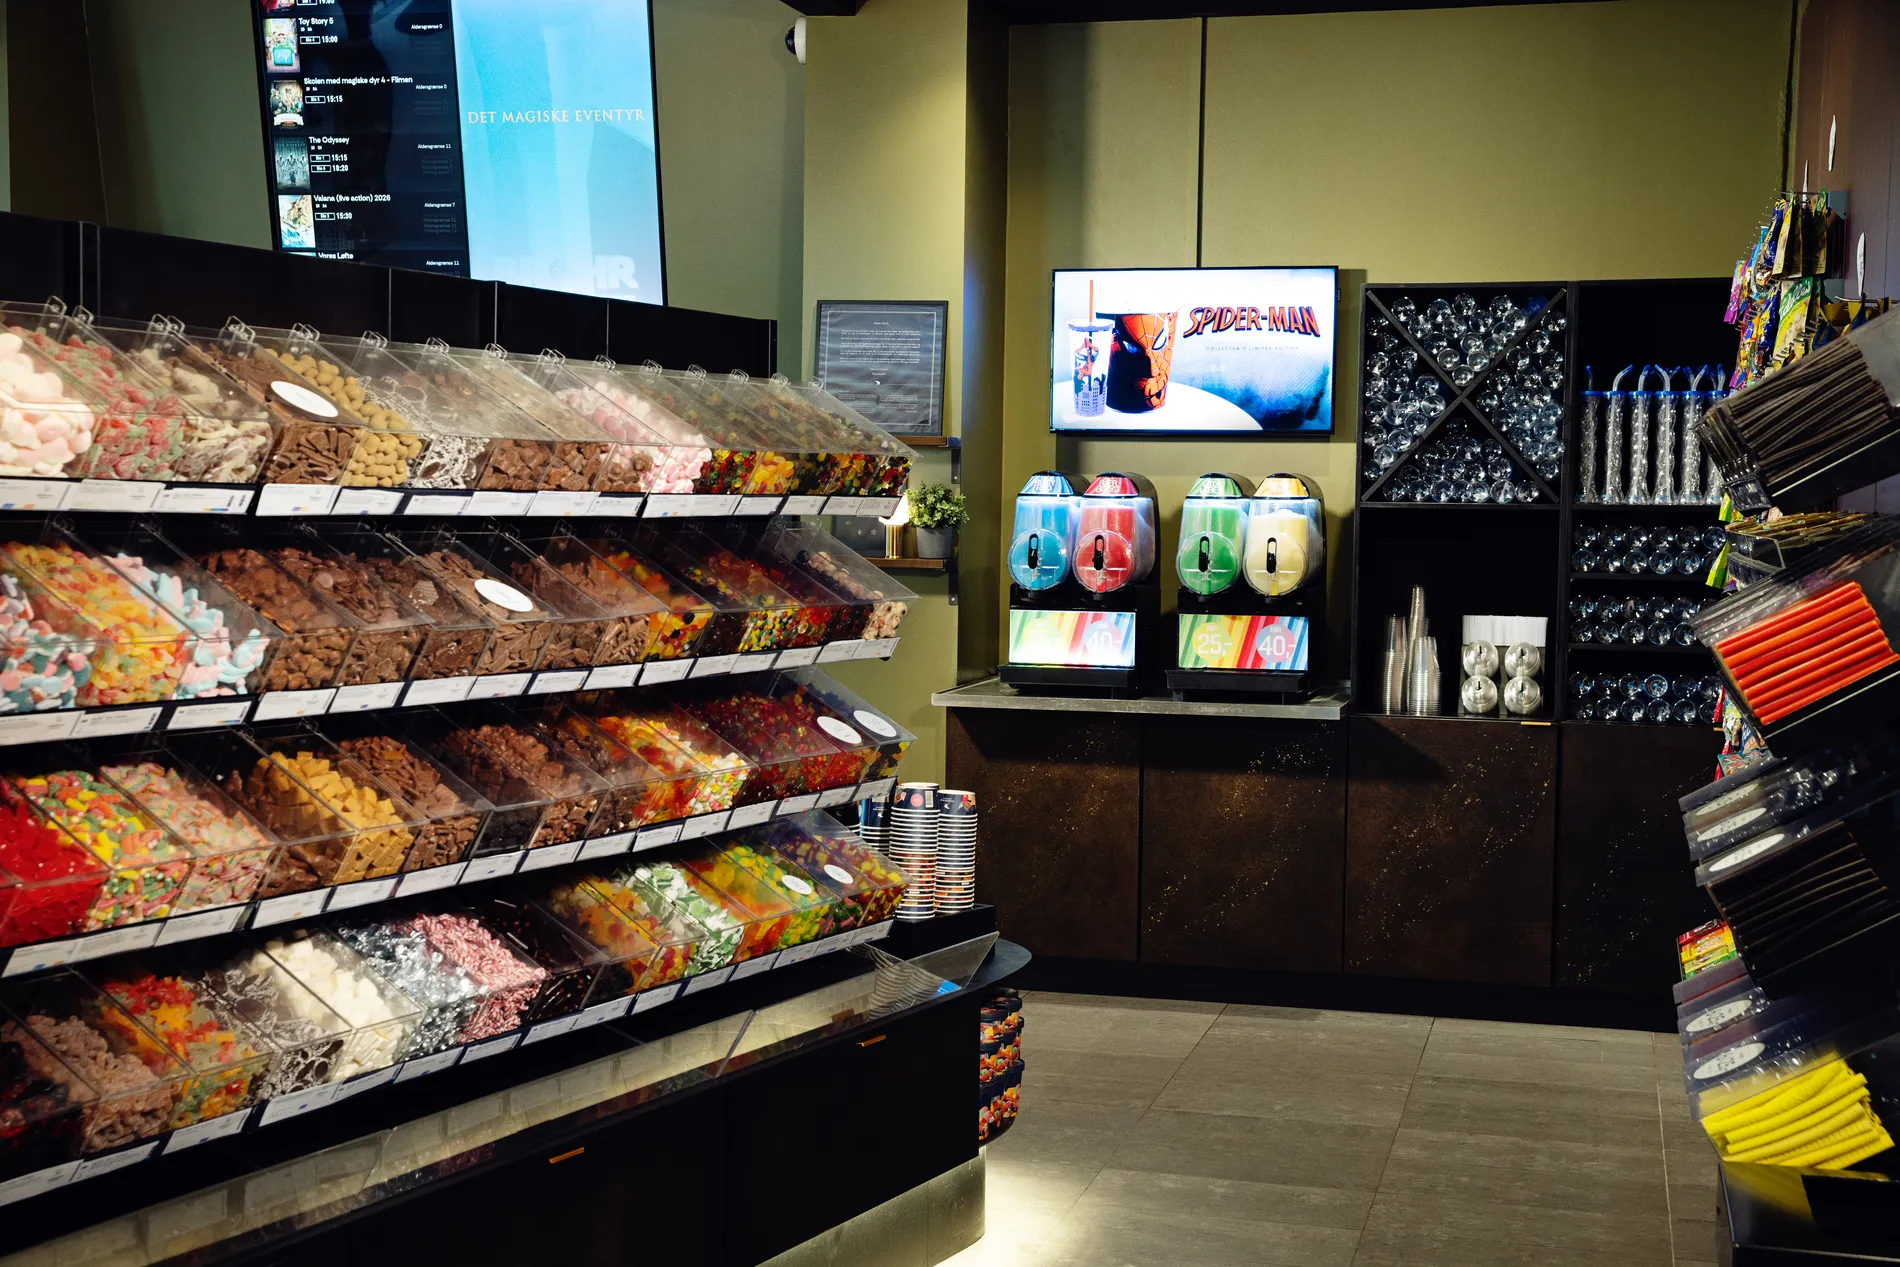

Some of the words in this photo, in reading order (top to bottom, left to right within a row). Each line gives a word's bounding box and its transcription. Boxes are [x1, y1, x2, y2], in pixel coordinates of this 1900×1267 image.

[298, 17, 309, 26] Toy
[310, 17, 328, 26] Story
[329, 17, 334, 25] 5
[321, 35, 338, 43] 15:00
[303, 77, 325, 85] Skolen
[326, 76, 340, 84] med
[342, 77, 368, 86] magiske
[369, 77, 380, 86] dyr
[391, 76, 413, 84] Filmen
[326, 95, 343, 103] 15:15
[467, 111, 496, 124] DET
[501, 109, 569, 123] MAGISKE
[575, 108, 646, 122] EVENTYR
[322, 136, 350, 145] Odyssey
[336, 194, 350, 203] (live
[351, 194, 373, 203] action)
[374, 194, 391, 202] 2026
[336, 212, 352, 220] 15:30
[1182, 306, 1321, 338] SPIDER-MAN
[1197, 633, 1233, 656] 25,-
[1257, 635, 1297, 659] 40,-
